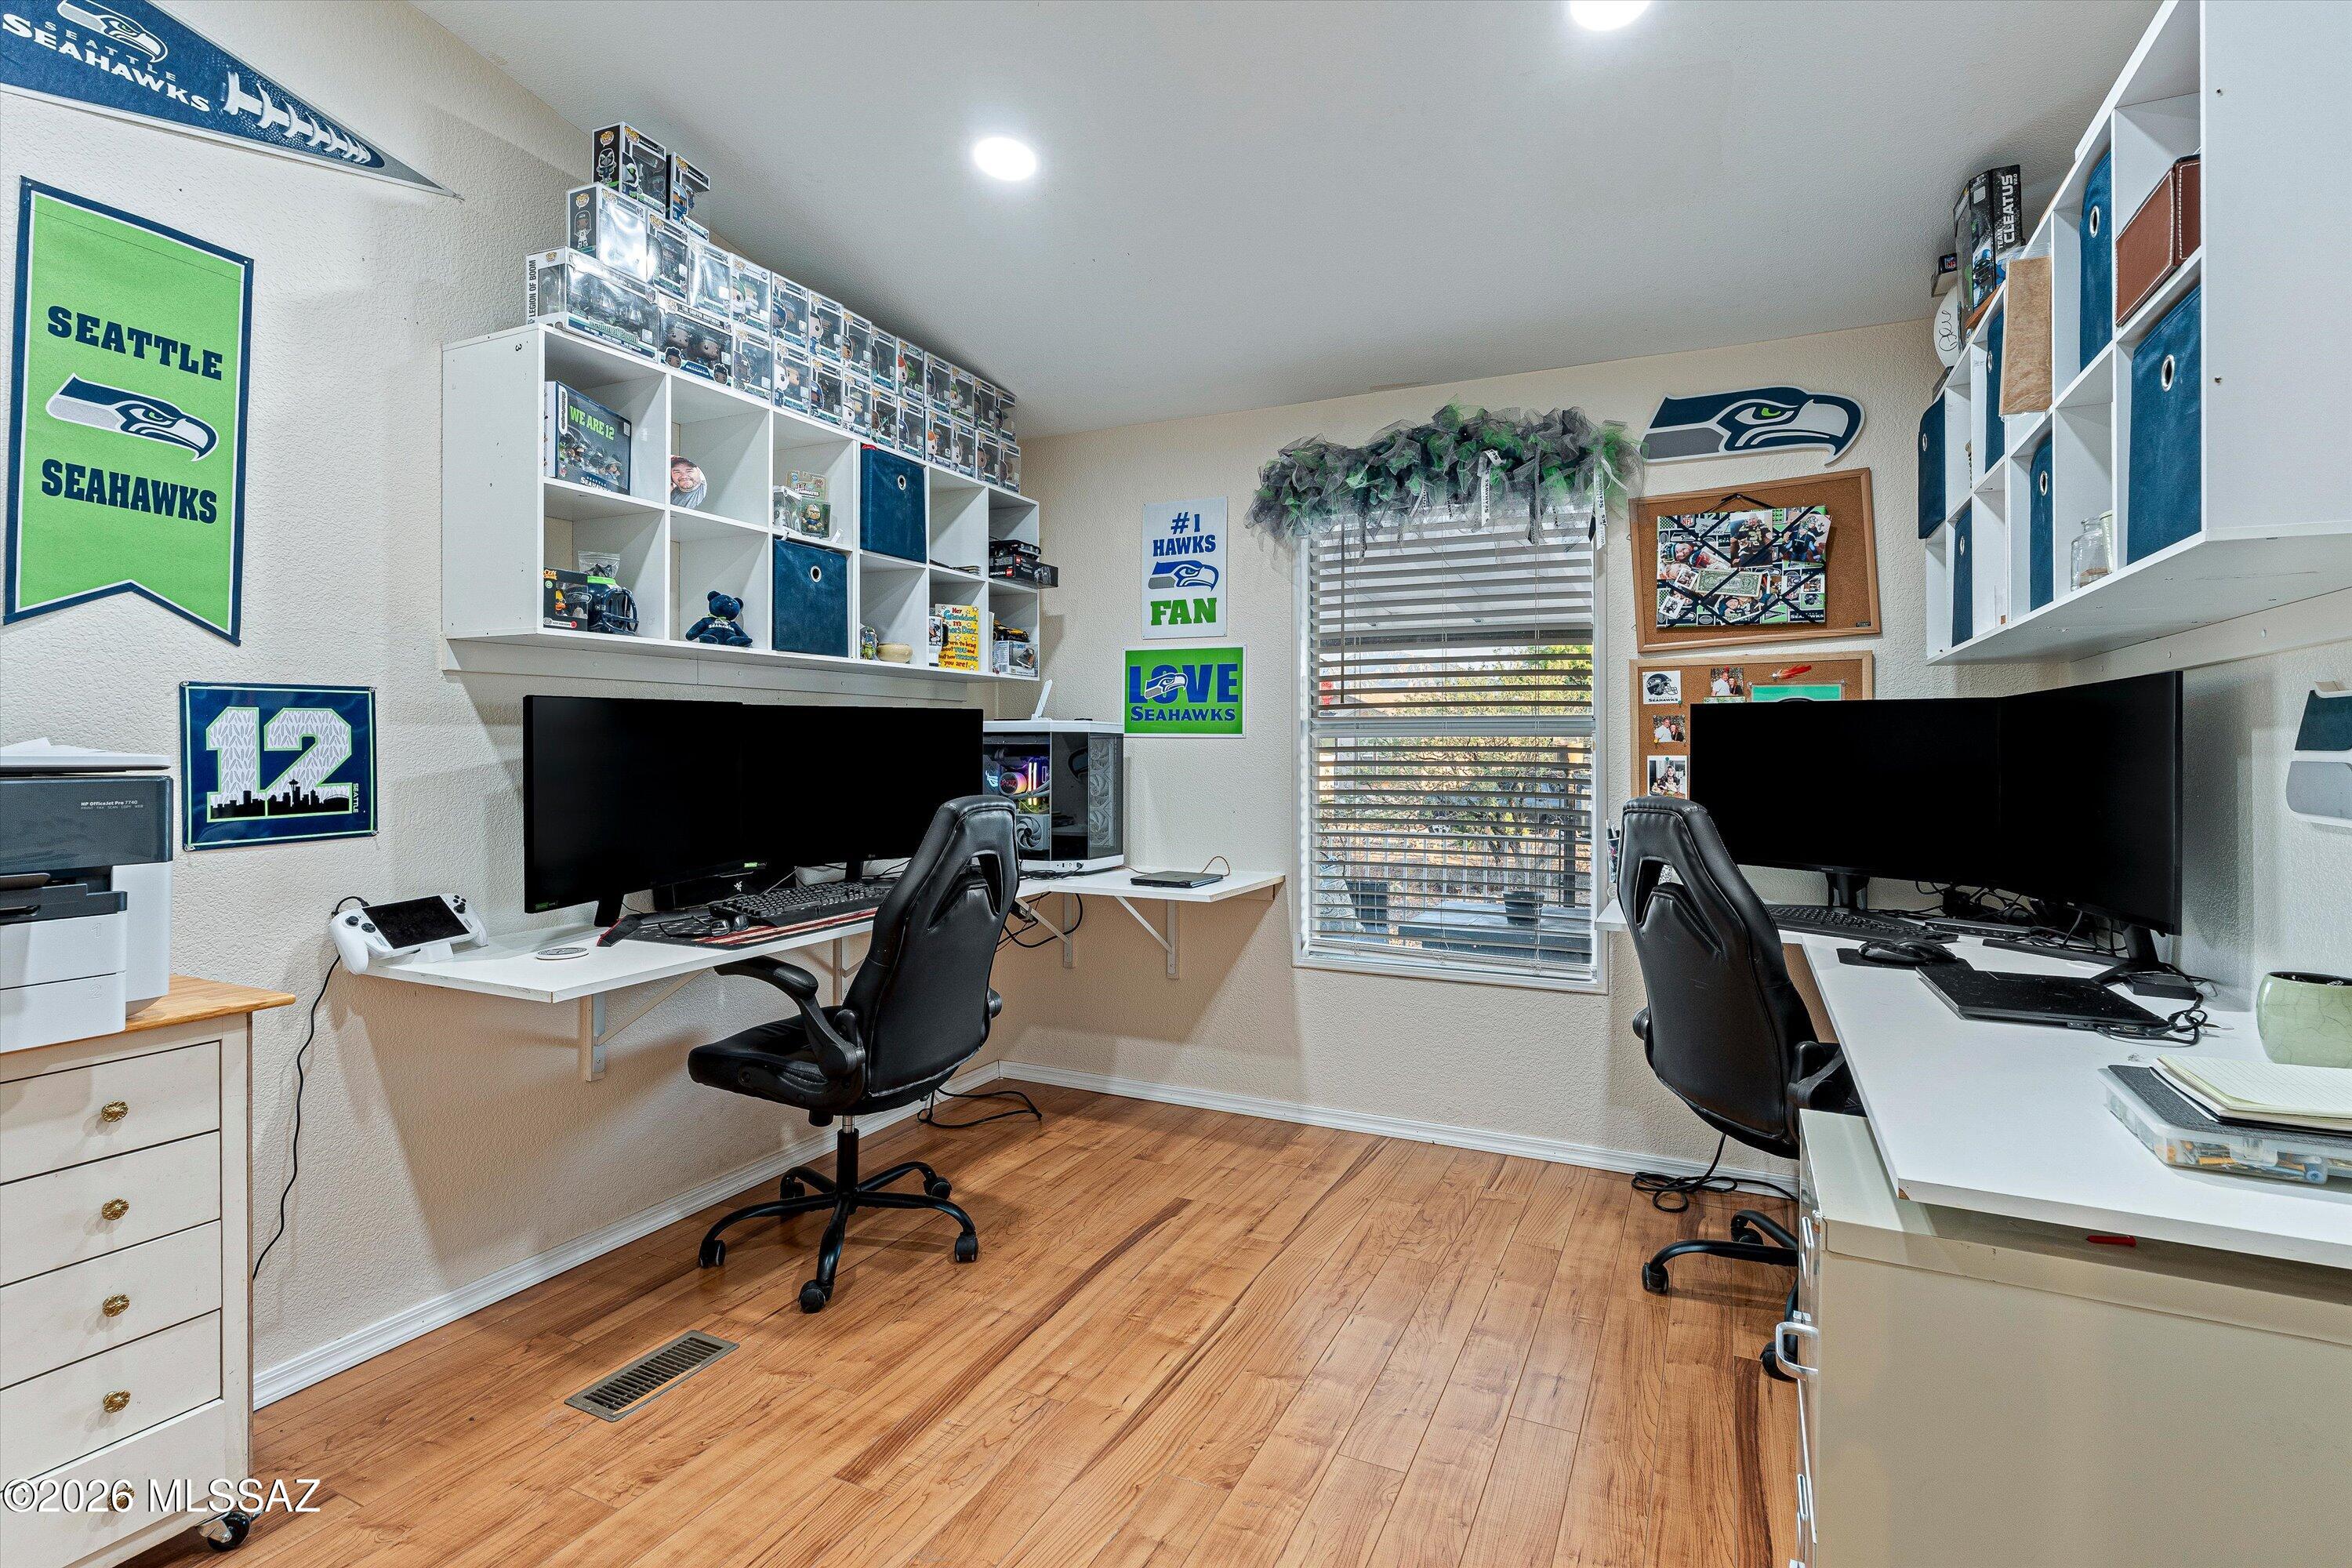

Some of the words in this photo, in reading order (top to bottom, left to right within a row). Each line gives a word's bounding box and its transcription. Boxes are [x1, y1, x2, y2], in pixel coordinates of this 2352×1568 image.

[2, 13, 210, 113] SEAHAWKS
[45, 20, 177, 82] SEATTLE
[2002, 174, 2016, 244] CLEATUS
[528, 282, 536, 292] OF
[47, 305, 223, 381] SEATTLE
[569, 405, 586, 426] WE
[586, 415, 605, 437] ARE
[605, 424, 615, 441] 12
[42, 459, 218, 524] SEAHAWKS
[1170, 511, 1201, 535] #1
[1152, 535, 1216, 557] HAWKS
[1150, 597, 1218, 626] FAN
[1128, 663, 1239, 705] LOVE
[1130, 706, 1236, 722] SEAHAWKS
[206, 706, 352, 823] 12
